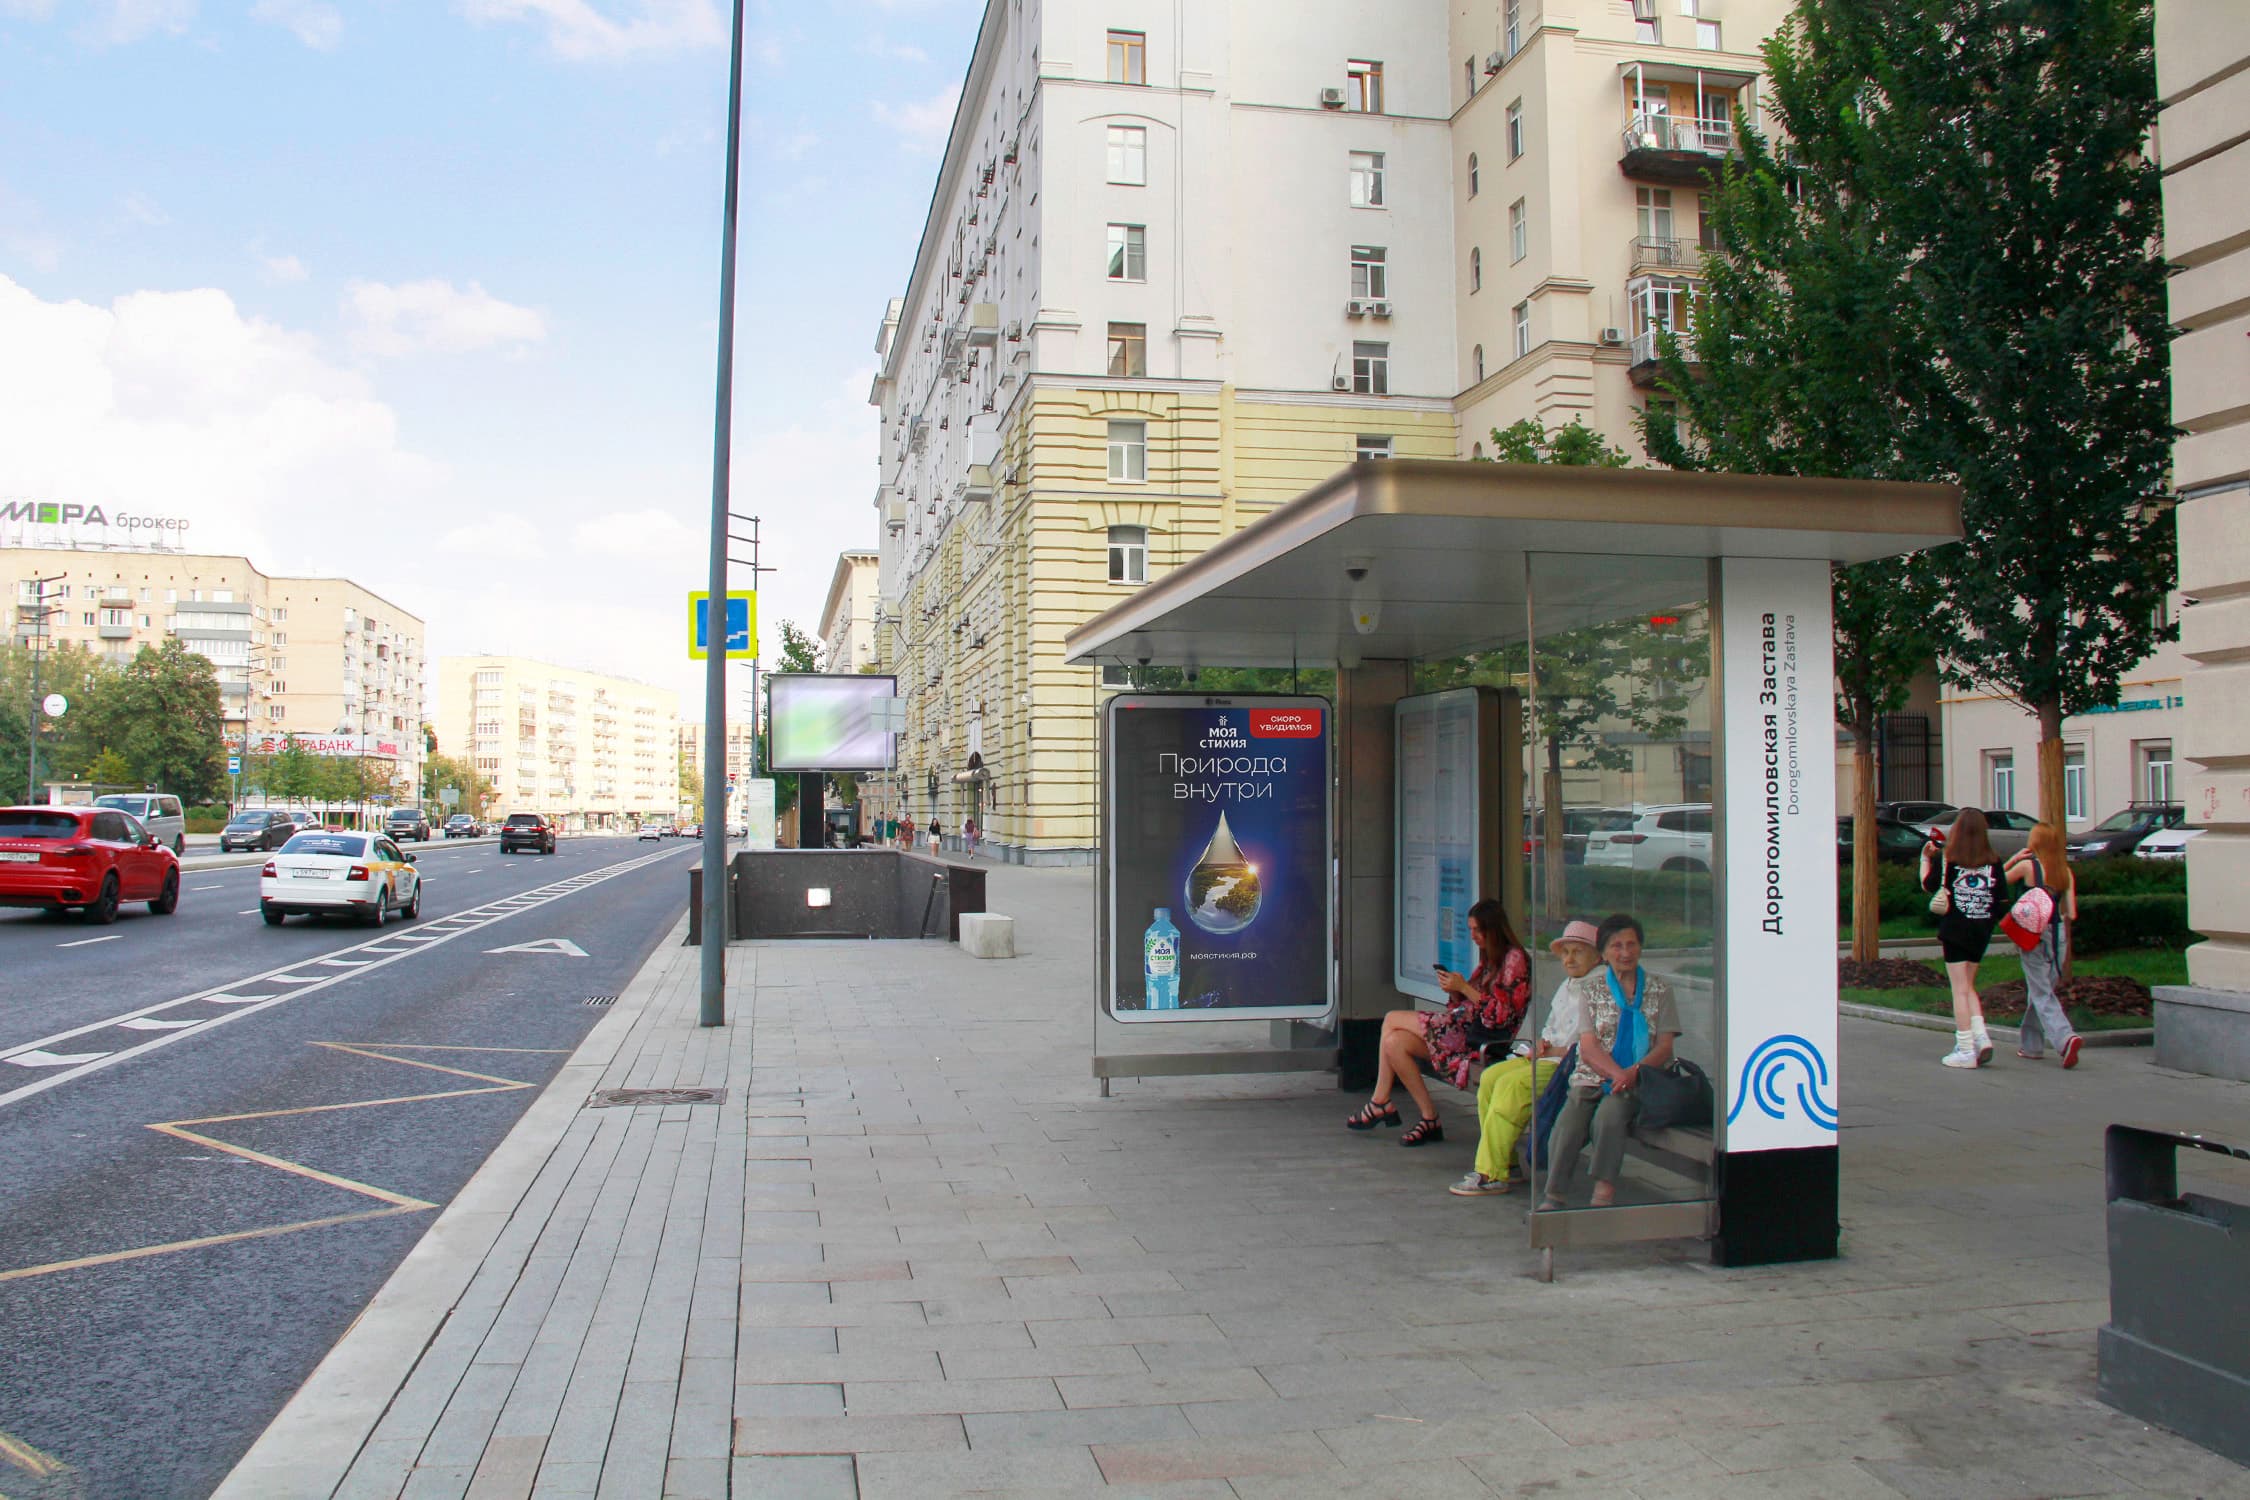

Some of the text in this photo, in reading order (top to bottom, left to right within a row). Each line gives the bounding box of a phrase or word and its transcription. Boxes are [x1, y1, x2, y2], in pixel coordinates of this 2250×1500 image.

[116, 513, 190, 532] брокер
[1271, 715, 1302, 723] СКОРО
[1784, 615, 1801, 815] Dorogomilovskaya Zastava
[1209, 727, 1237, 738] МОЯ
[1259, 724, 1313, 732] УВИДИМСЯ
[1199, 739, 1247, 748] СТИХИЯ
[1159, 753, 1288, 777] Природа
[1760, 612, 1784, 935] Дорогомиловская Застава
[1173, 782, 1272, 803] внутри
